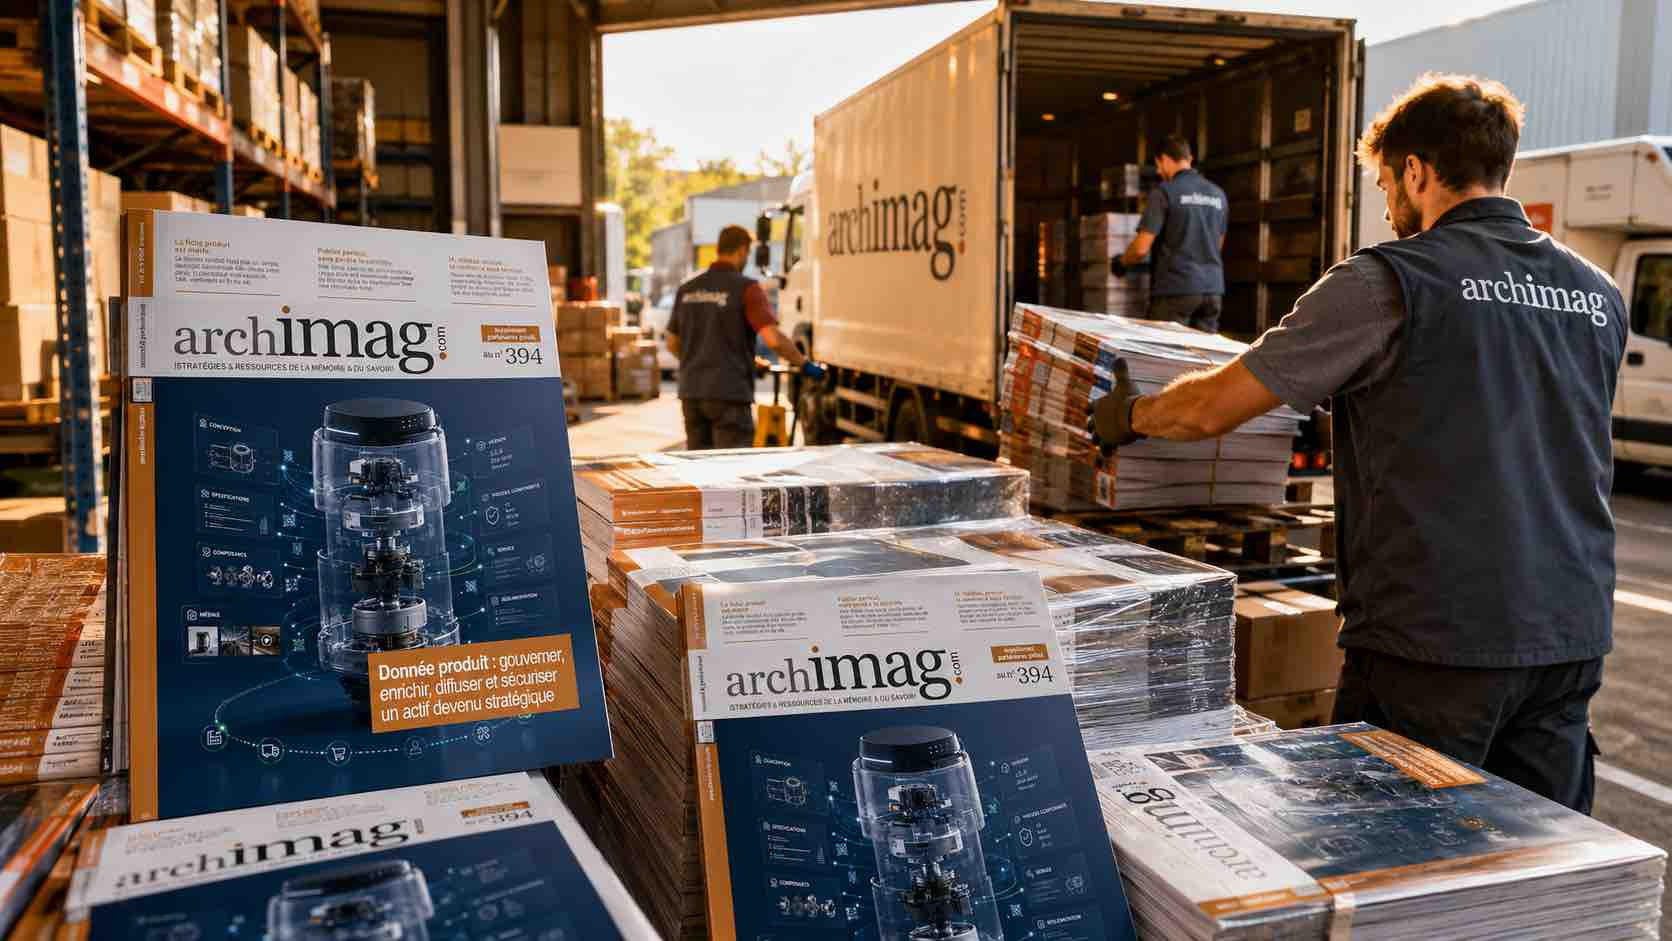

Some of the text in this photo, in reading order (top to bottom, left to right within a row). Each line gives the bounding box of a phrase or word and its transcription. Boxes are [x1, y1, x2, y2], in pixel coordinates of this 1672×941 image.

[828, 178, 957, 281] archimag
[1460, 271, 1608, 327] archimag
[174, 305, 435, 374] archimag
[436, 326, 448, 361] .com
[505, 347, 543, 365] 394
[235, 362, 288, 371] RESSOURCES
[301, 363, 310, 371] LA
[378, 659, 435, 681] Donnée
[439, 655, 489, 678] produit
[499, 649, 566, 671] gouverner,
[726, 644, 952, 700] archimag
[950, 649, 962, 685] .com
[1017, 665, 1054, 684] 394
[379, 669, 558, 702] enrichir, diffuser et sécuriser
[381, 689, 555, 722] un actif devenu stratégique
[114, 818, 408, 889] archimag
